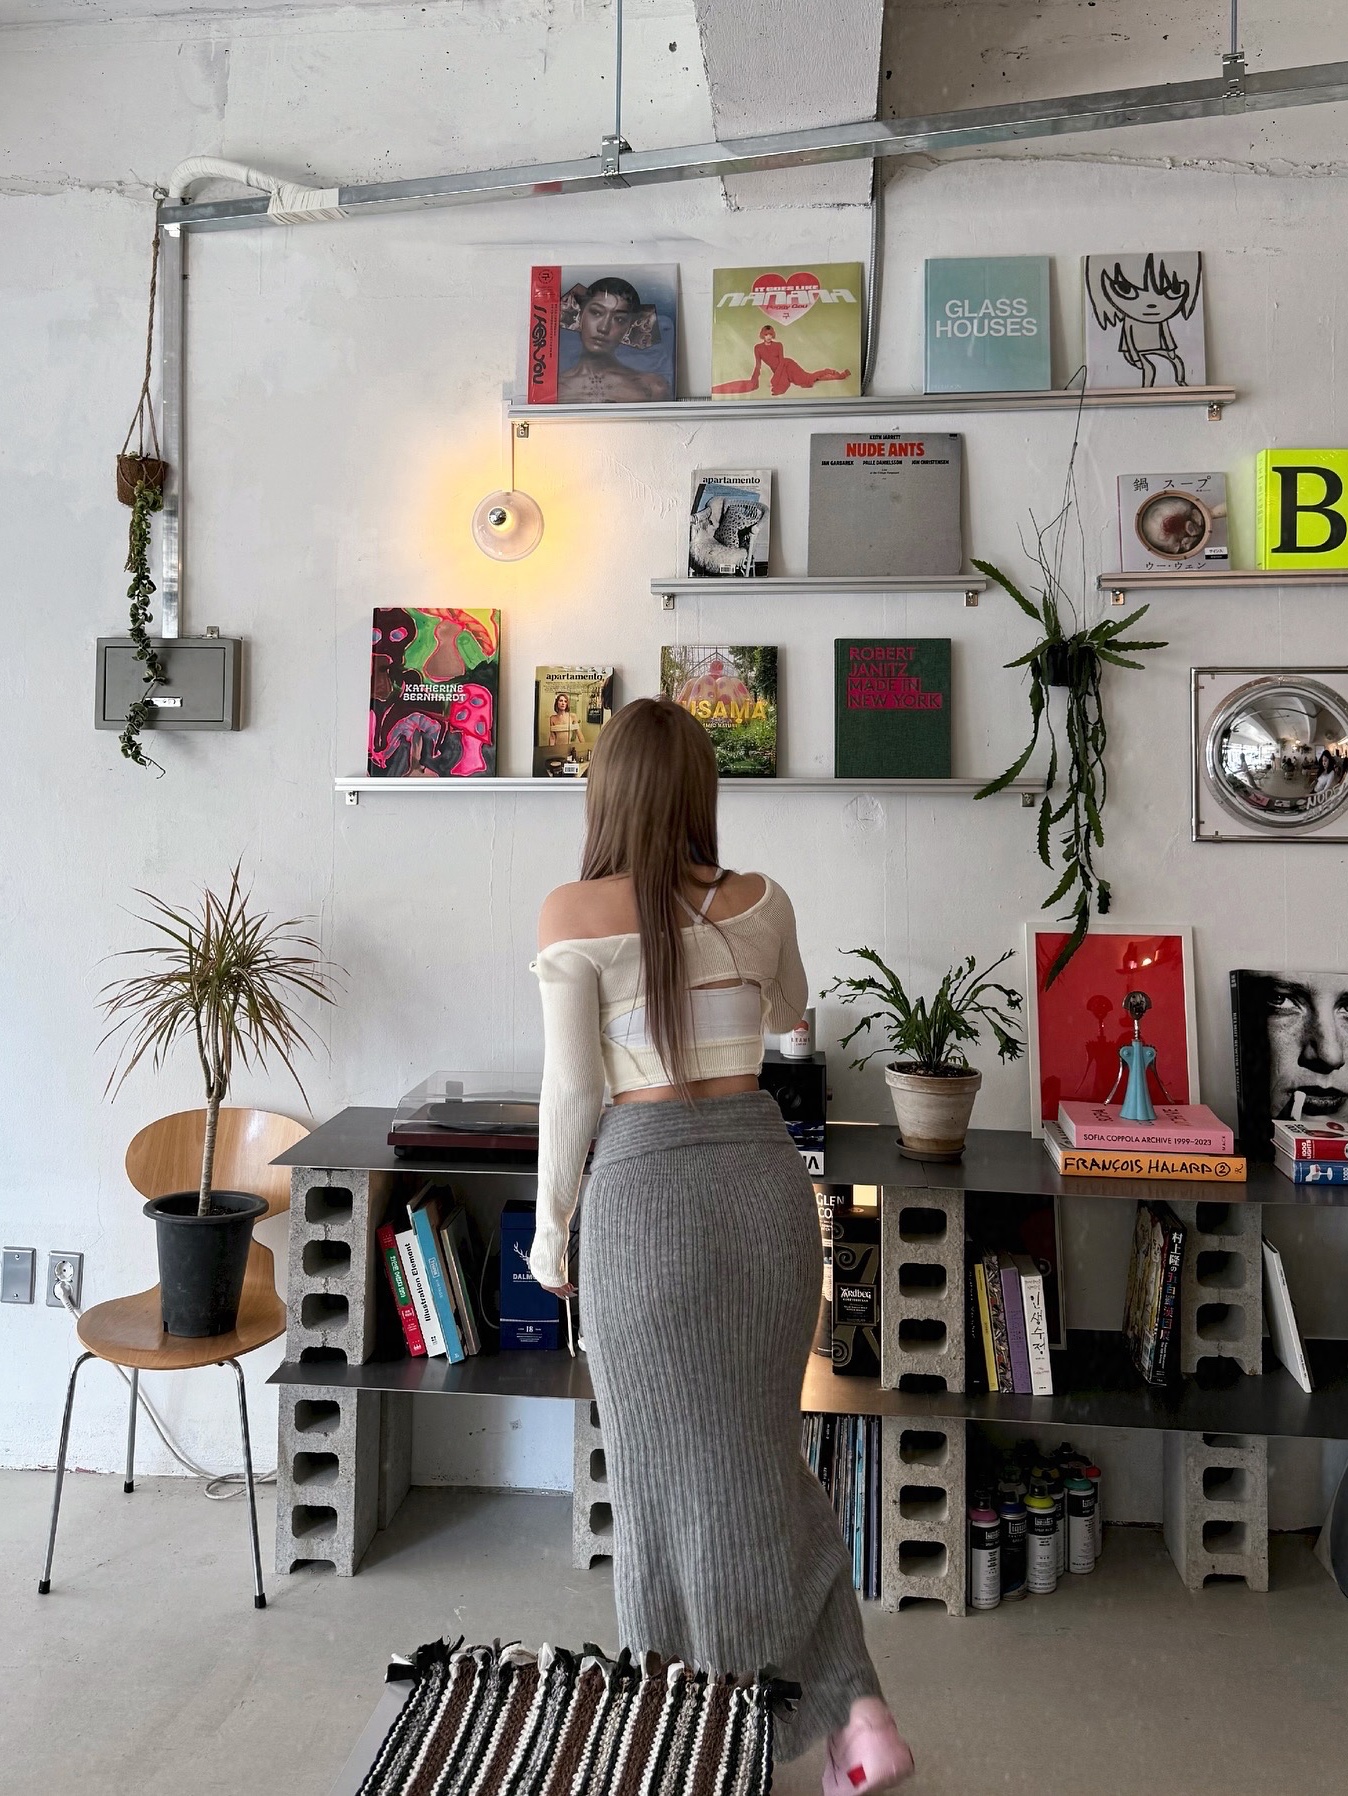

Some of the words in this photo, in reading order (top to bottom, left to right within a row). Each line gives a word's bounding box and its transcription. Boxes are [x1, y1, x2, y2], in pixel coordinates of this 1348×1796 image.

[945, 298, 1028, 318] GLASS
[936, 318, 1037, 338] HOUSES
[846, 443, 885, 457] NUDE
[888, 442, 925, 456] ANTS
[1133, 477, 1149, 492] 鍋
[1162, 475, 1211, 489] スープ
[1271, 466, 1347, 553] B
[1146, 562, 1206, 570] ウー・ウェン
[849, 647, 916, 660] ROBERT
[849, 662, 908, 677] JANITZ
[405, 684, 464, 692] KATHERINE
[849, 679, 896, 691] MADE
[903, 679, 919, 691] IN
[403, 693, 466, 701] BERNHARDT
[849, 695, 887, 707] NEW
[894, 694, 940, 707] YORK
[1106, 1135, 1140, 1143] COPPOLA
[1141, 1136, 1172, 1145] ARCHIVE
[1064, 1158, 1143, 1174] FRANÇOIS
[1148, 1159, 1212, 1175] HALARD
[816, 1192, 845, 1206] GLEN
[405, 1243, 419, 1276] Element
[416, 1276, 432, 1321] Illustration
[840, 1287, 871, 1299] Ardbeg
[1030, 1292, 1045, 1355] 인생수정
